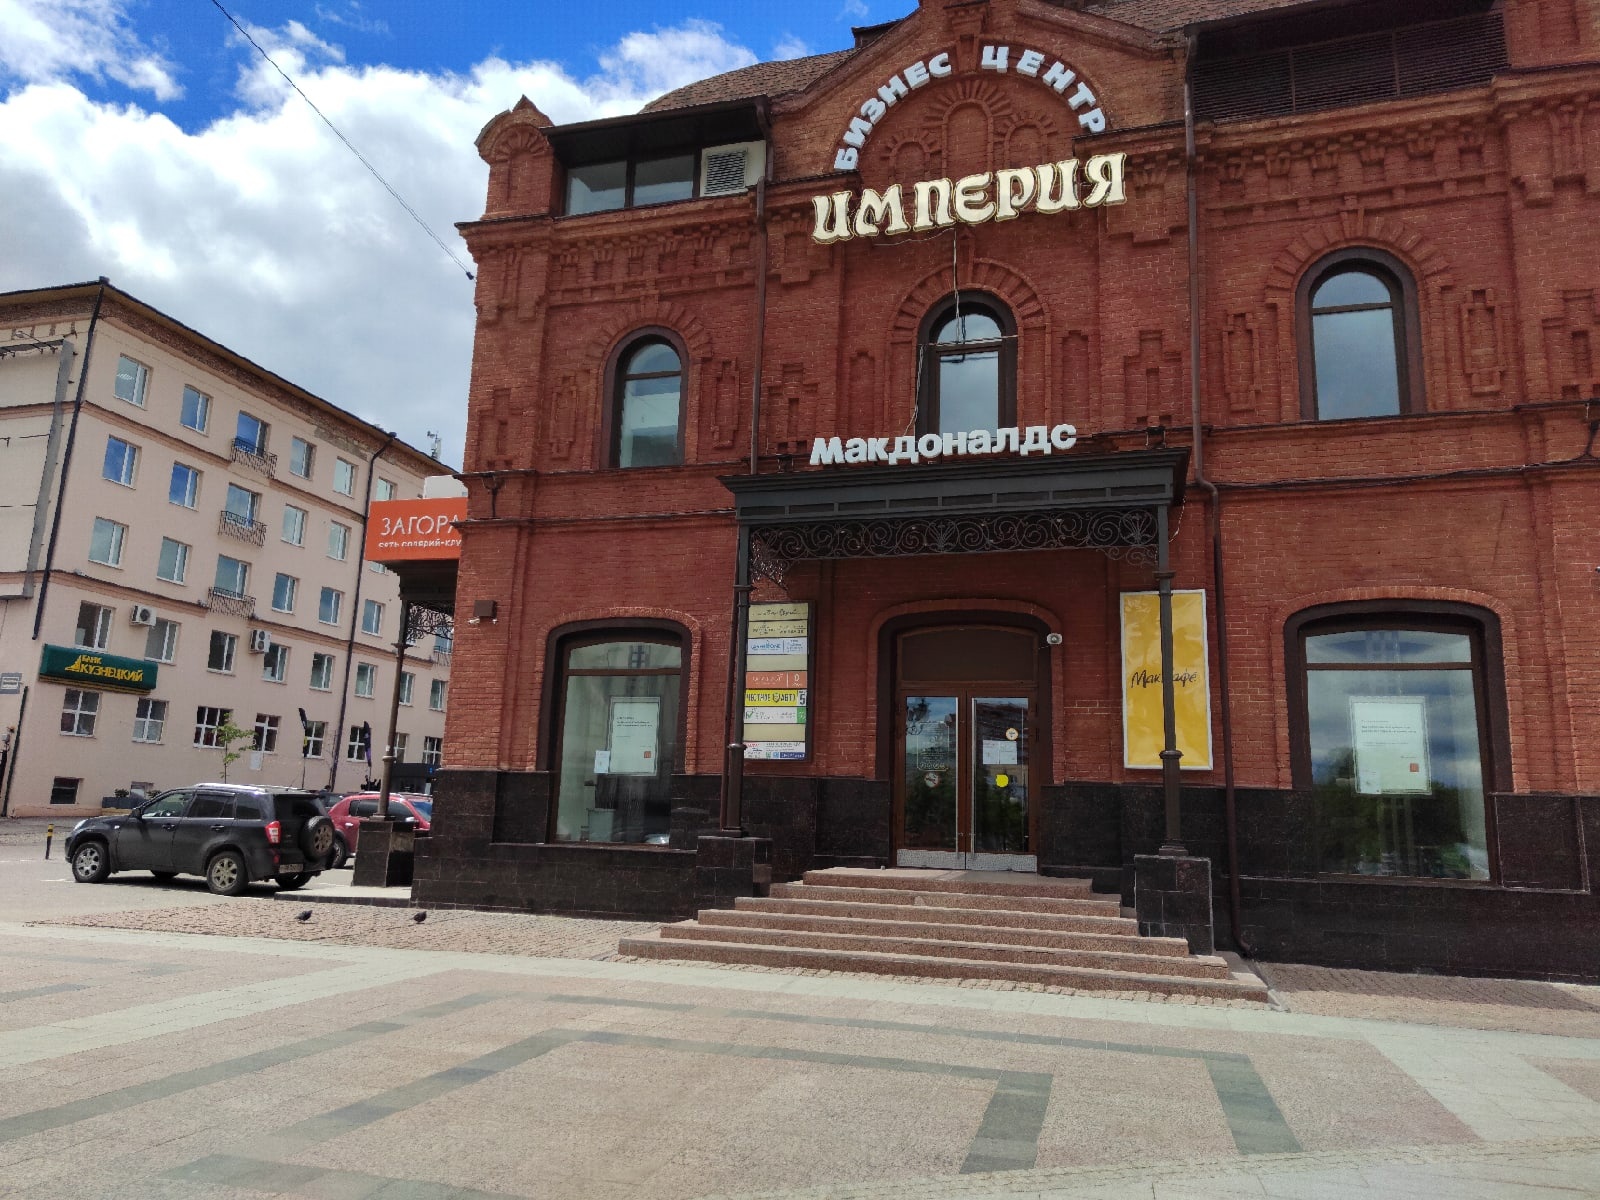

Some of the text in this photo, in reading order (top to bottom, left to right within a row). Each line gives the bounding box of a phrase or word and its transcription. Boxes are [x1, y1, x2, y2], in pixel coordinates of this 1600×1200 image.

[834, 45, 1106, 171] БИЗНЕС ЦЕНТР
[811, 152, 1127, 244] ИМПЕРИЯ
[80, 664, 143, 682] КУЗНЕЦКИЙ
[81, 655, 102, 664] БАНК
